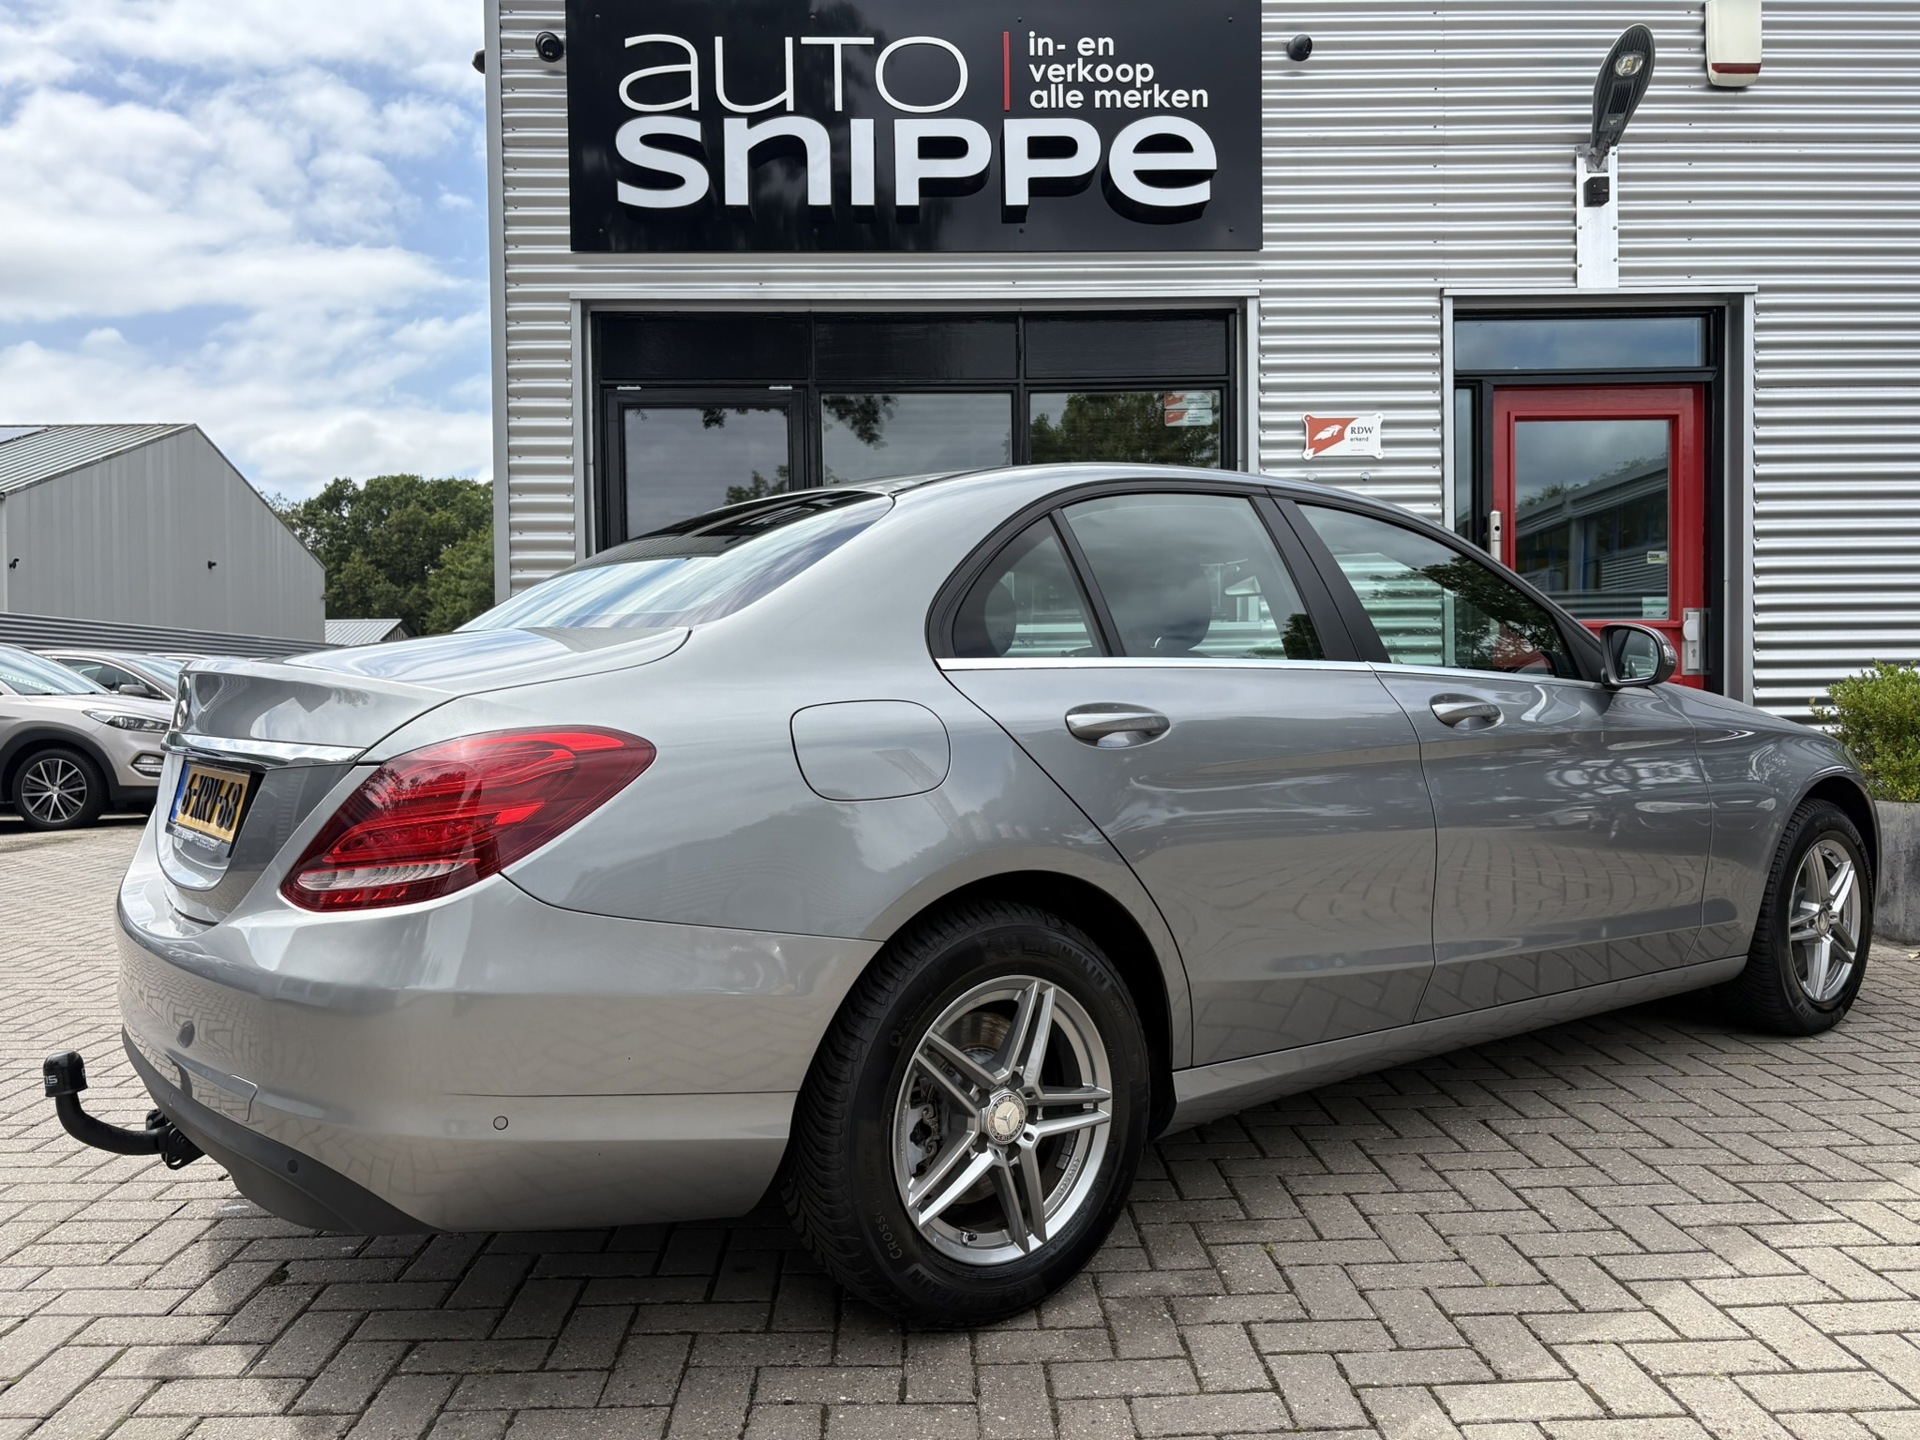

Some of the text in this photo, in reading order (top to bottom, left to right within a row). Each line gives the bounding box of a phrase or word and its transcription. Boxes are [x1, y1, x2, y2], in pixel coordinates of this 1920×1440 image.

[1029, 31, 1114, 56] in- en
[1029, 58, 1154, 88] verkoop
[1030, 84, 1208, 108] alle merken
[1350, 426, 1374, 434] RDW
